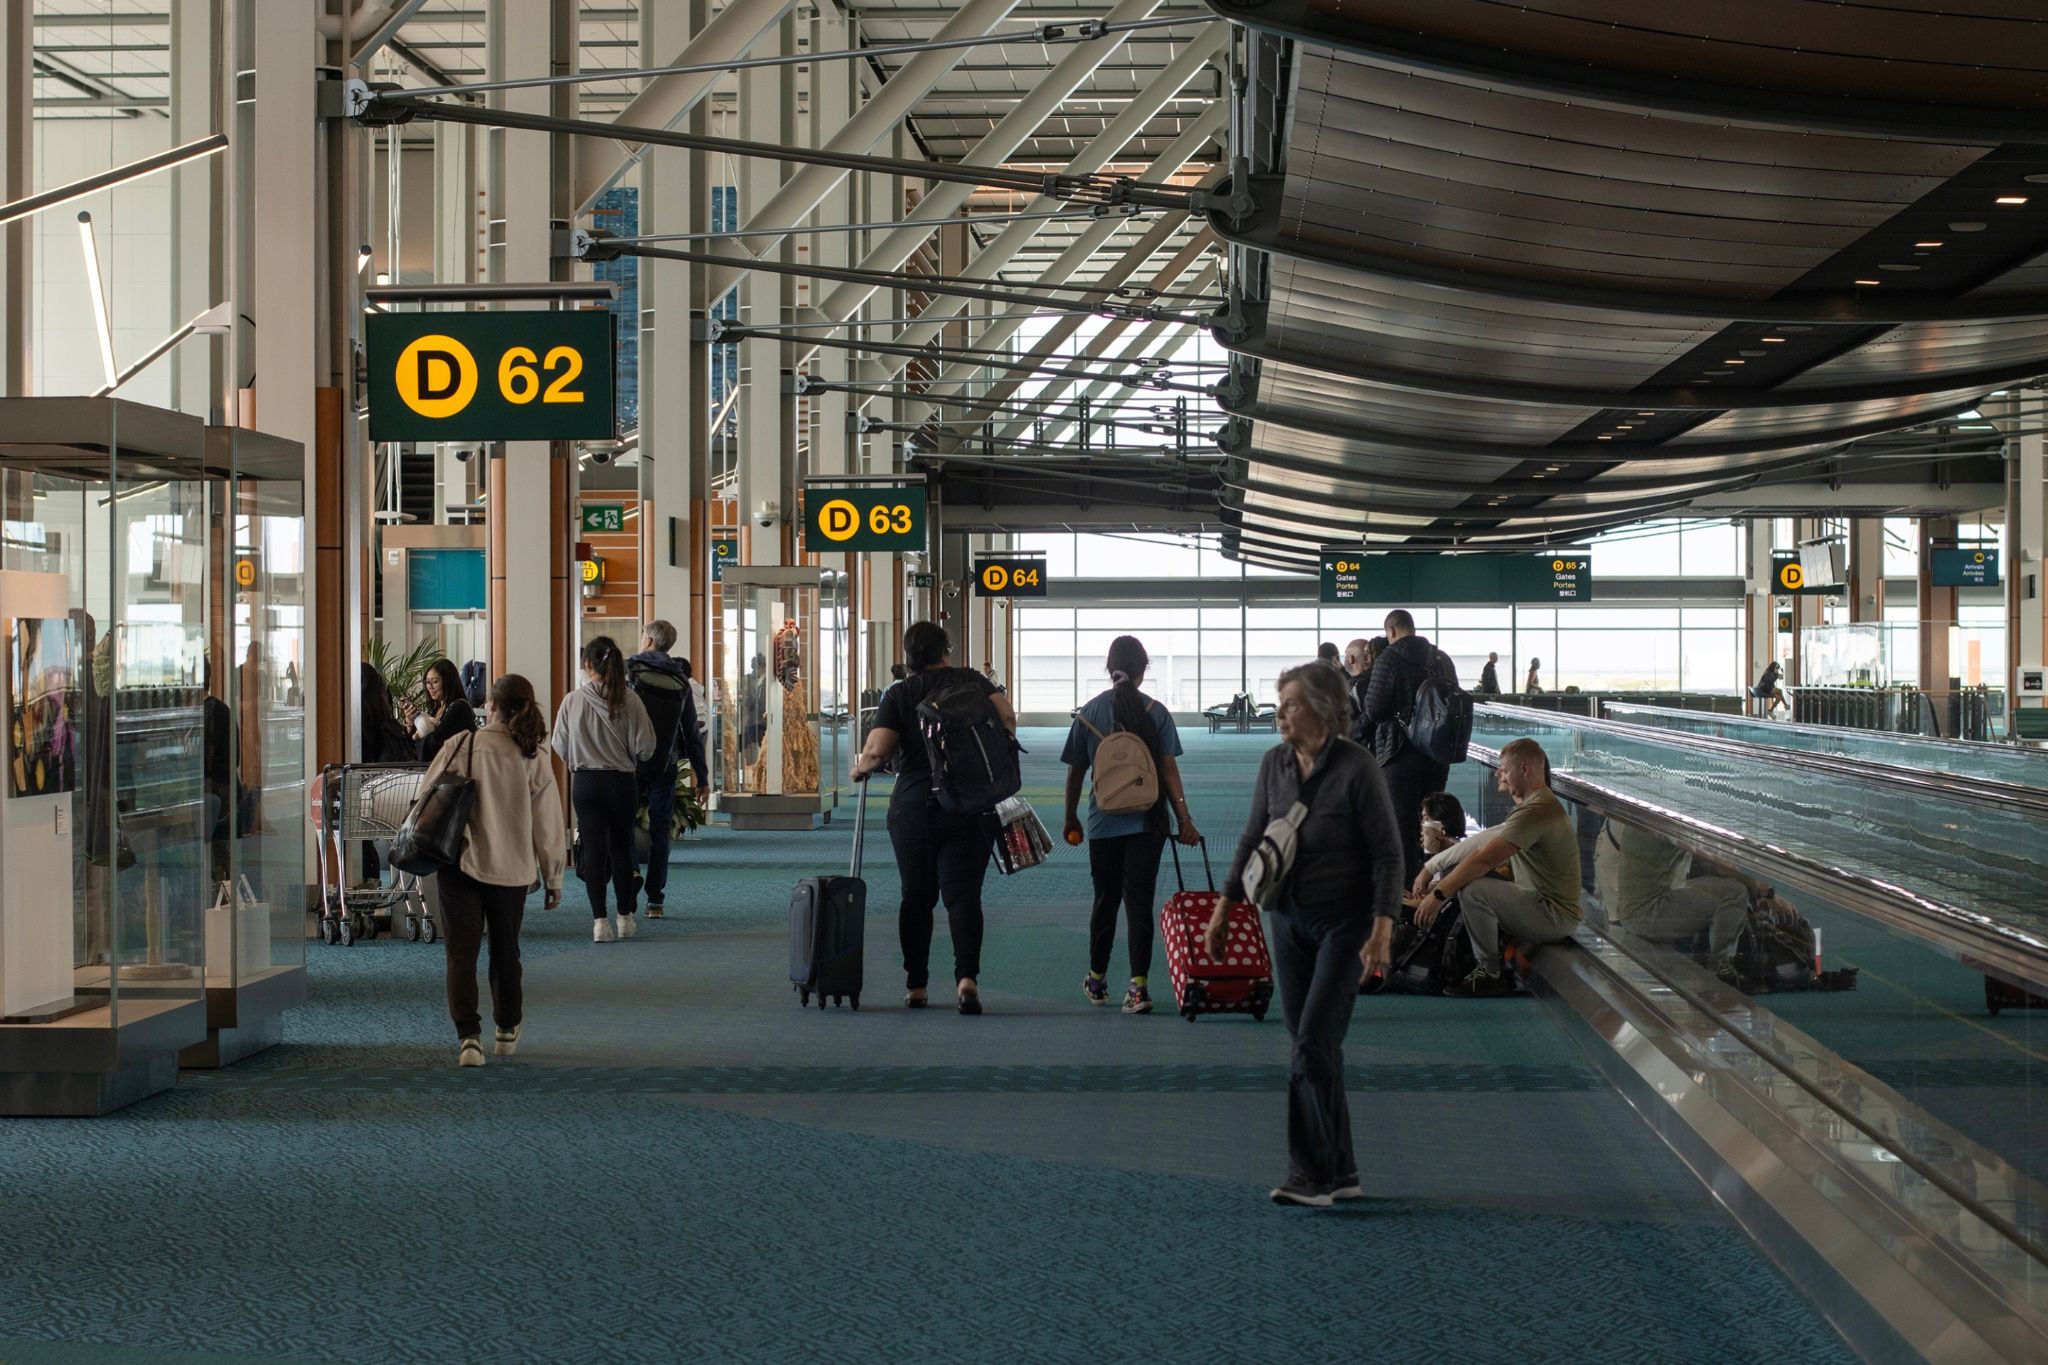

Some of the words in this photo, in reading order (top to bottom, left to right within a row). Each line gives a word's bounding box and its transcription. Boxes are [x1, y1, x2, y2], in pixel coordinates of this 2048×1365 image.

[417, 350, 462, 400] D
[498, 346, 585, 405] 62
[829, 507, 852, 532] D
[869, 504, 912, 534] 63
[1566, 562, 1577, 570] 65
[989, 570, 1003, 585] D
[1013, 569, 1039, 587] 64
[1787, 568, 1801, 583] D
